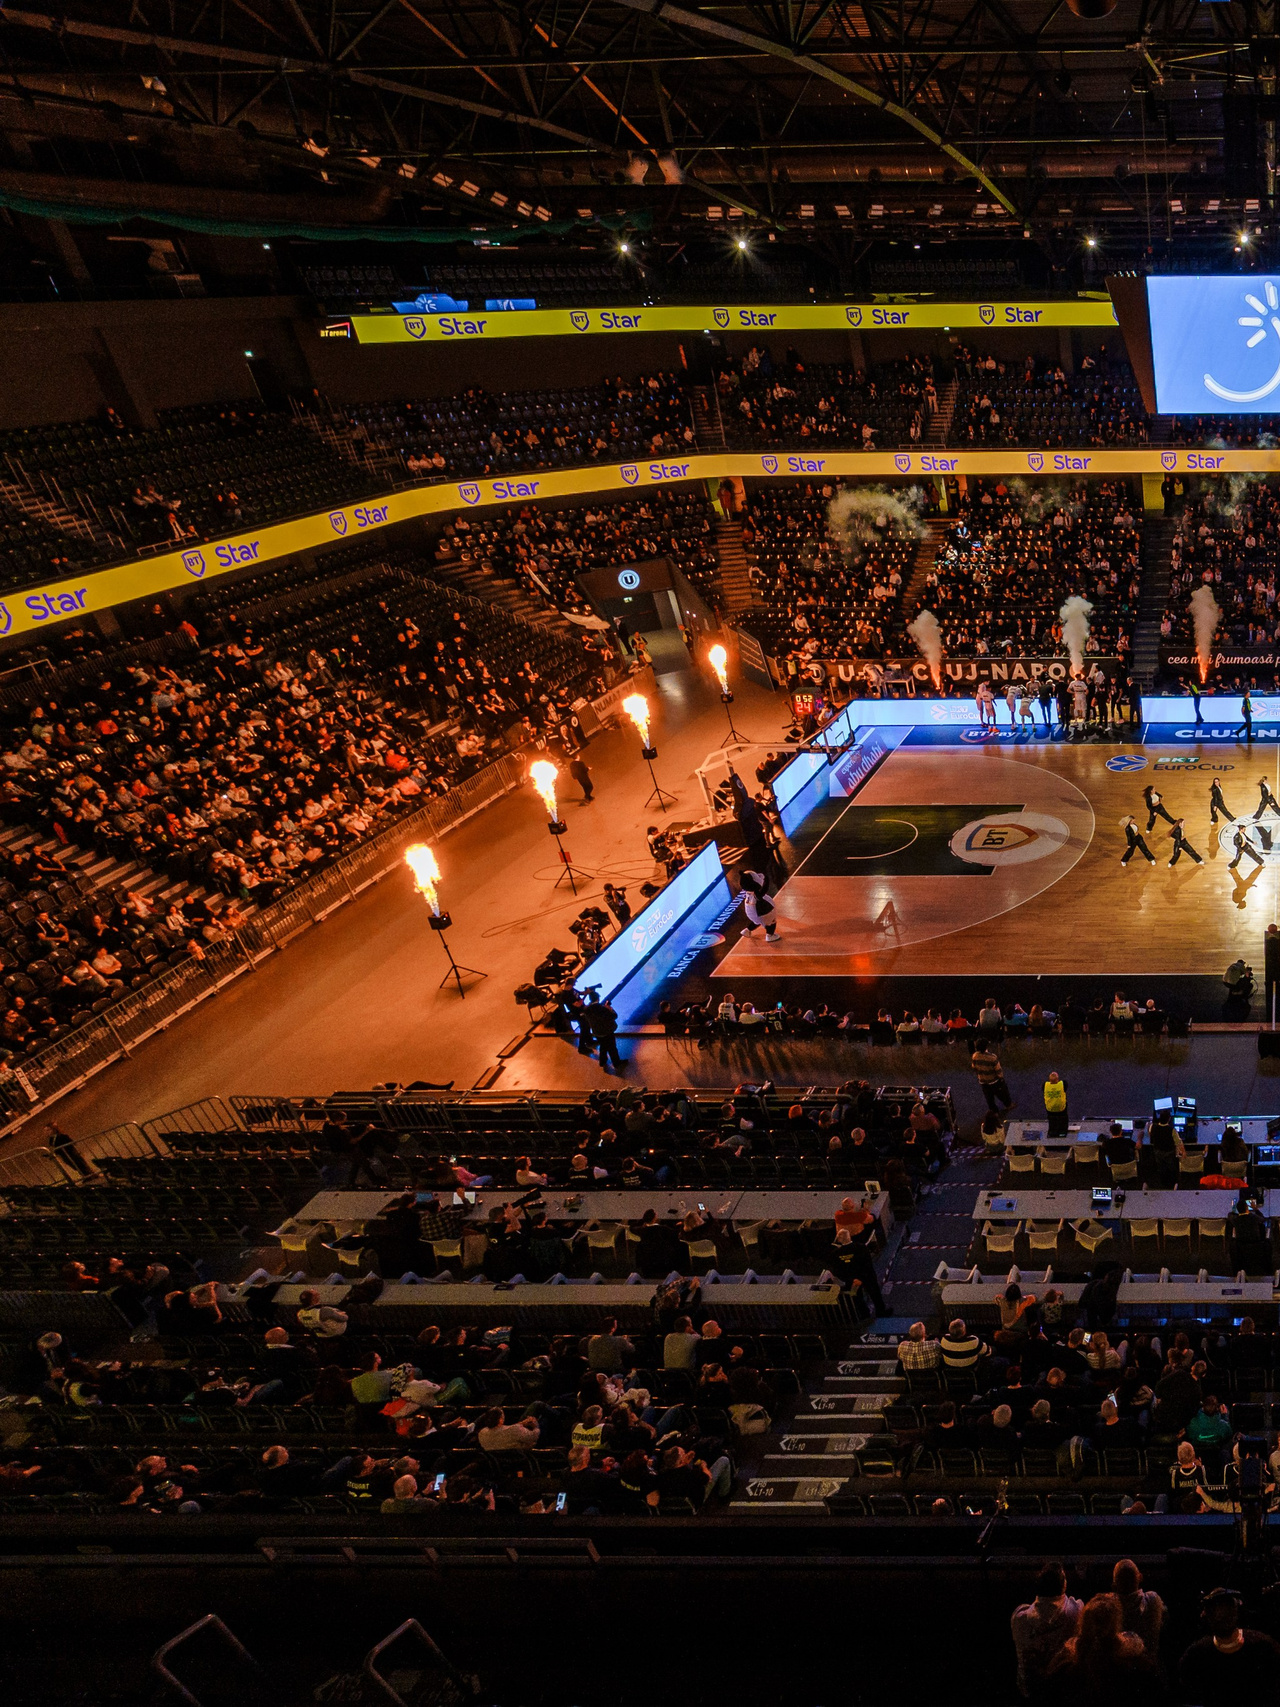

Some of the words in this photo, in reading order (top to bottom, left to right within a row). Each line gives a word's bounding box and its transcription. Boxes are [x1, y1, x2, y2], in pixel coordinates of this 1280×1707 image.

[601, 313, 641, 328] Star
[740, 310, 776, 326] Star
[873, 309, 909, 324] Star
[1005, 307, 1042, 323] Star
[439, 318, 487, 335] Star
[788, 457, 826, 472] Star
[921, 456, 959, 471] Star
[1054, 455, 1092, 470] Star
[1187, 454, 1225, 469] Star
[650, 464, 690, 480] Star
[464, 488, 475, 497] BT
[493, 482, 540, 499] Star
[334, 516, 343, 526] BT
[355, 506, 388, 527] Star
[188, 555, 200, 567] BT
[216, 541, 260, 567] Star
[25, 588, 87, 620] Star
[1167, 655, 1189, 664] cea
[1214, 652, 1274, 669] frumoasă
[797, 702, 812, 713] 24
[1153, 764, 1235, 772] EuroCup
[982, 829, 1008, 846] BT
[649, 909, 674, 938] EuroCup
[667, 950, 700, 978] BANCA
[755, 1487, 775, 1496] L1-10
